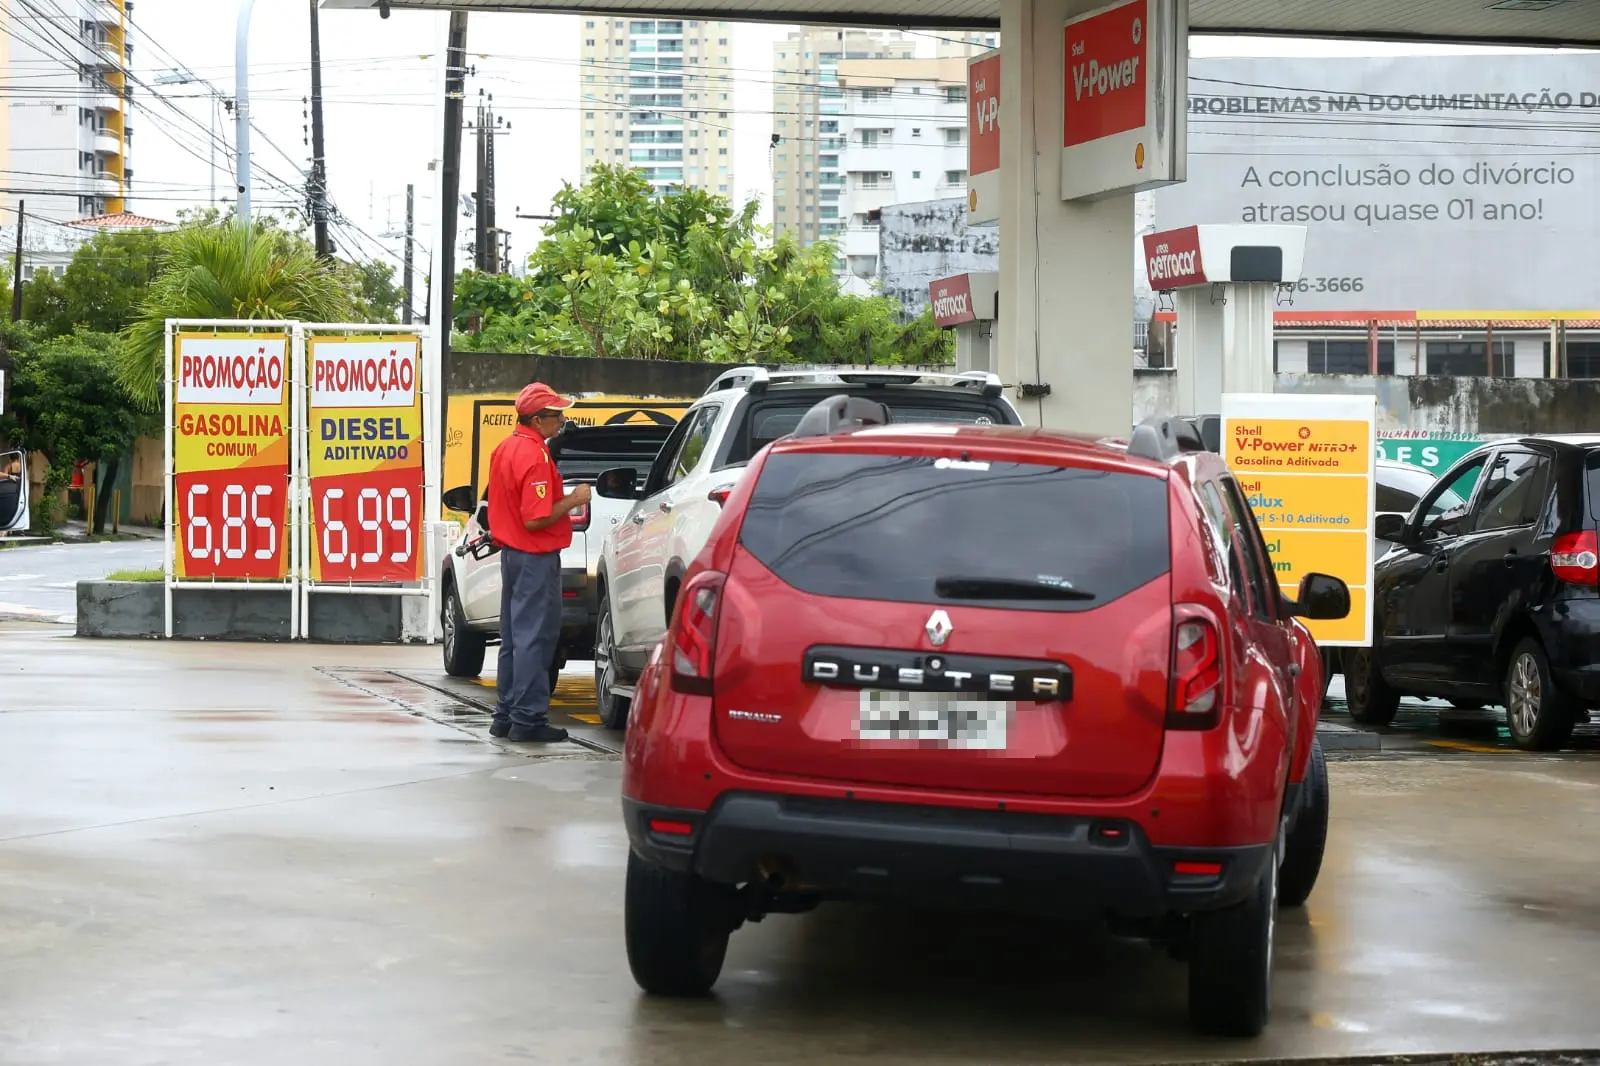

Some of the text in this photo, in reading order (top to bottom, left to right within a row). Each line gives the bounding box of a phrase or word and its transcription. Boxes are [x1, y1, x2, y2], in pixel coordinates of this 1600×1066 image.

[1071, 40, 1084, 57] Shell
[975, 79, 985, 93] Shell
[1072, 55, 1139, 102] V-Power
[1327, 95, 1362, 112] NA
[1368, 88, 1573, 115] DOCUMENTAÇÃO
[1580, 92, 1600, 109] D
[976, 97, 1000, 135] V-P
[1241, 161, 1575, 188] A conclusão do divórcio
[1242, 198, 1544, 227] atrasou quase 01 ano!
[1273, 277, 1364, 293] 06-3666
[182, 347, 282, 397] PROMOÇÃO
[315, 350, 413, 400] PROMOÇÃO
[180, 414, 283, 437] GASOLINA
[321, 418, 409, 441] DIESEL
[482, 414, 513, 426] ACEITE
[1235, 425, 1262, 436] Shell
[206, 442, 257, 457] COMUM
[324, 445, 409, 460] ADITIVADO
[1235, 438, 1304, 452] V-Power
[1235, 456, 1339, 467] Gasolina Aditivada
[1241, 481, 1261, 491] hell
[1247, 493, 1283, 508] ólux
[187, 484, 275, 567] 6,85
[322, 487, 412, 570] 6,99
[1269, 514, 1294, 523] S-10
[1297, 514, 1351, 524] Aditivado
[813, 662, 1059, 695] DUSTER
